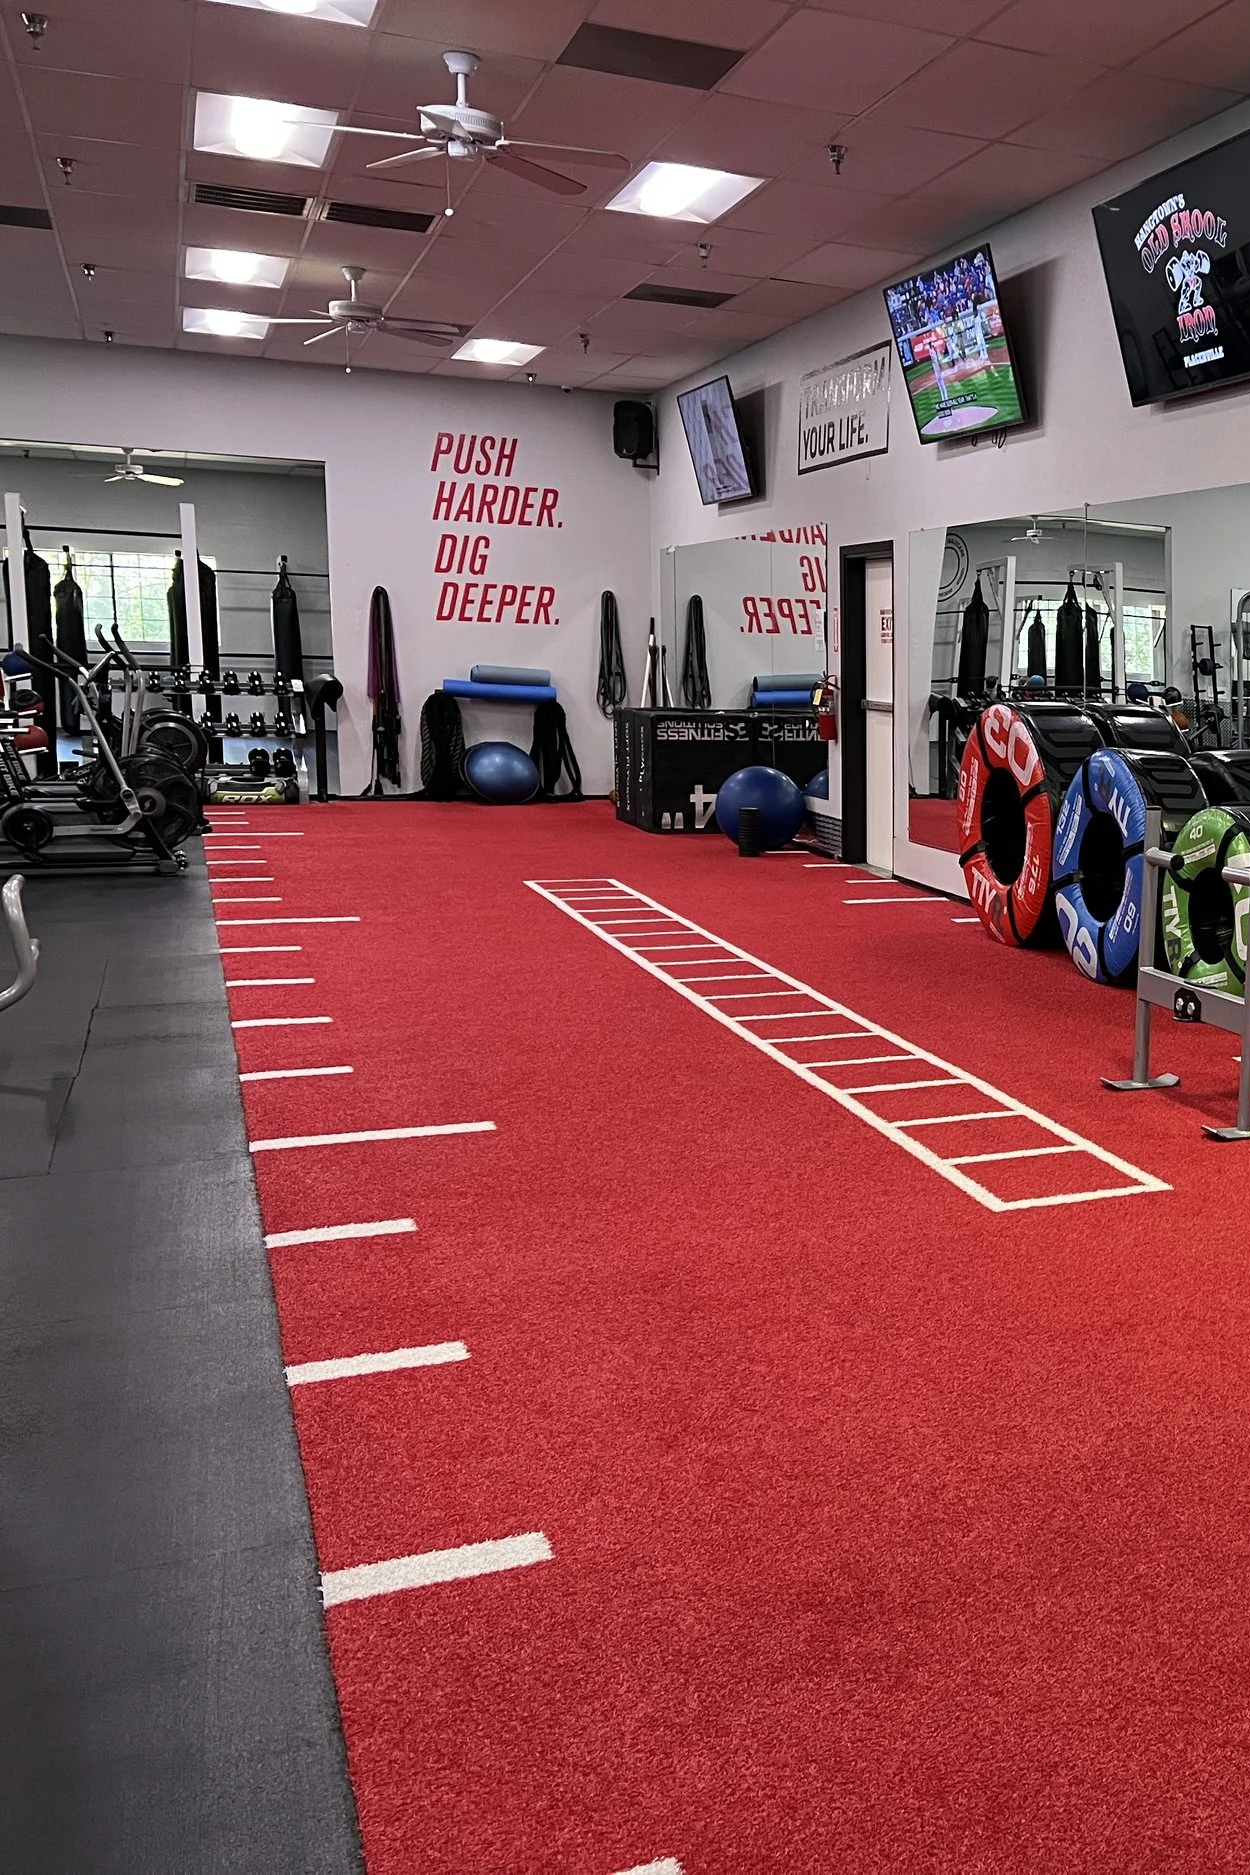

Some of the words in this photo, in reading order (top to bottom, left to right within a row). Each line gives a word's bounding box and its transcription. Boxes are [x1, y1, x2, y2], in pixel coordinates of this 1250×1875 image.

[1141, 223, 1170, 273] OLD
[1170, 208, 1228, 248] SKOOL
[1177, 305, 1218, 342] IRON
[430, 432, 519, 477] PUSH
[803, 420, 836, 461] YOUR
[839, 410, 869, 452] LIFE.
[432, 480, 563, 528] HARDER.
[434, 533, 490, 575] DIG
[435, 581, 561, 625] DEEPER.
[656, 729, 723, 741] FITNESS
[3, 773, 20, 797] BIKE
[222, 795, 272, 803] RDX
[1190, 825, 1203, 840] 40
